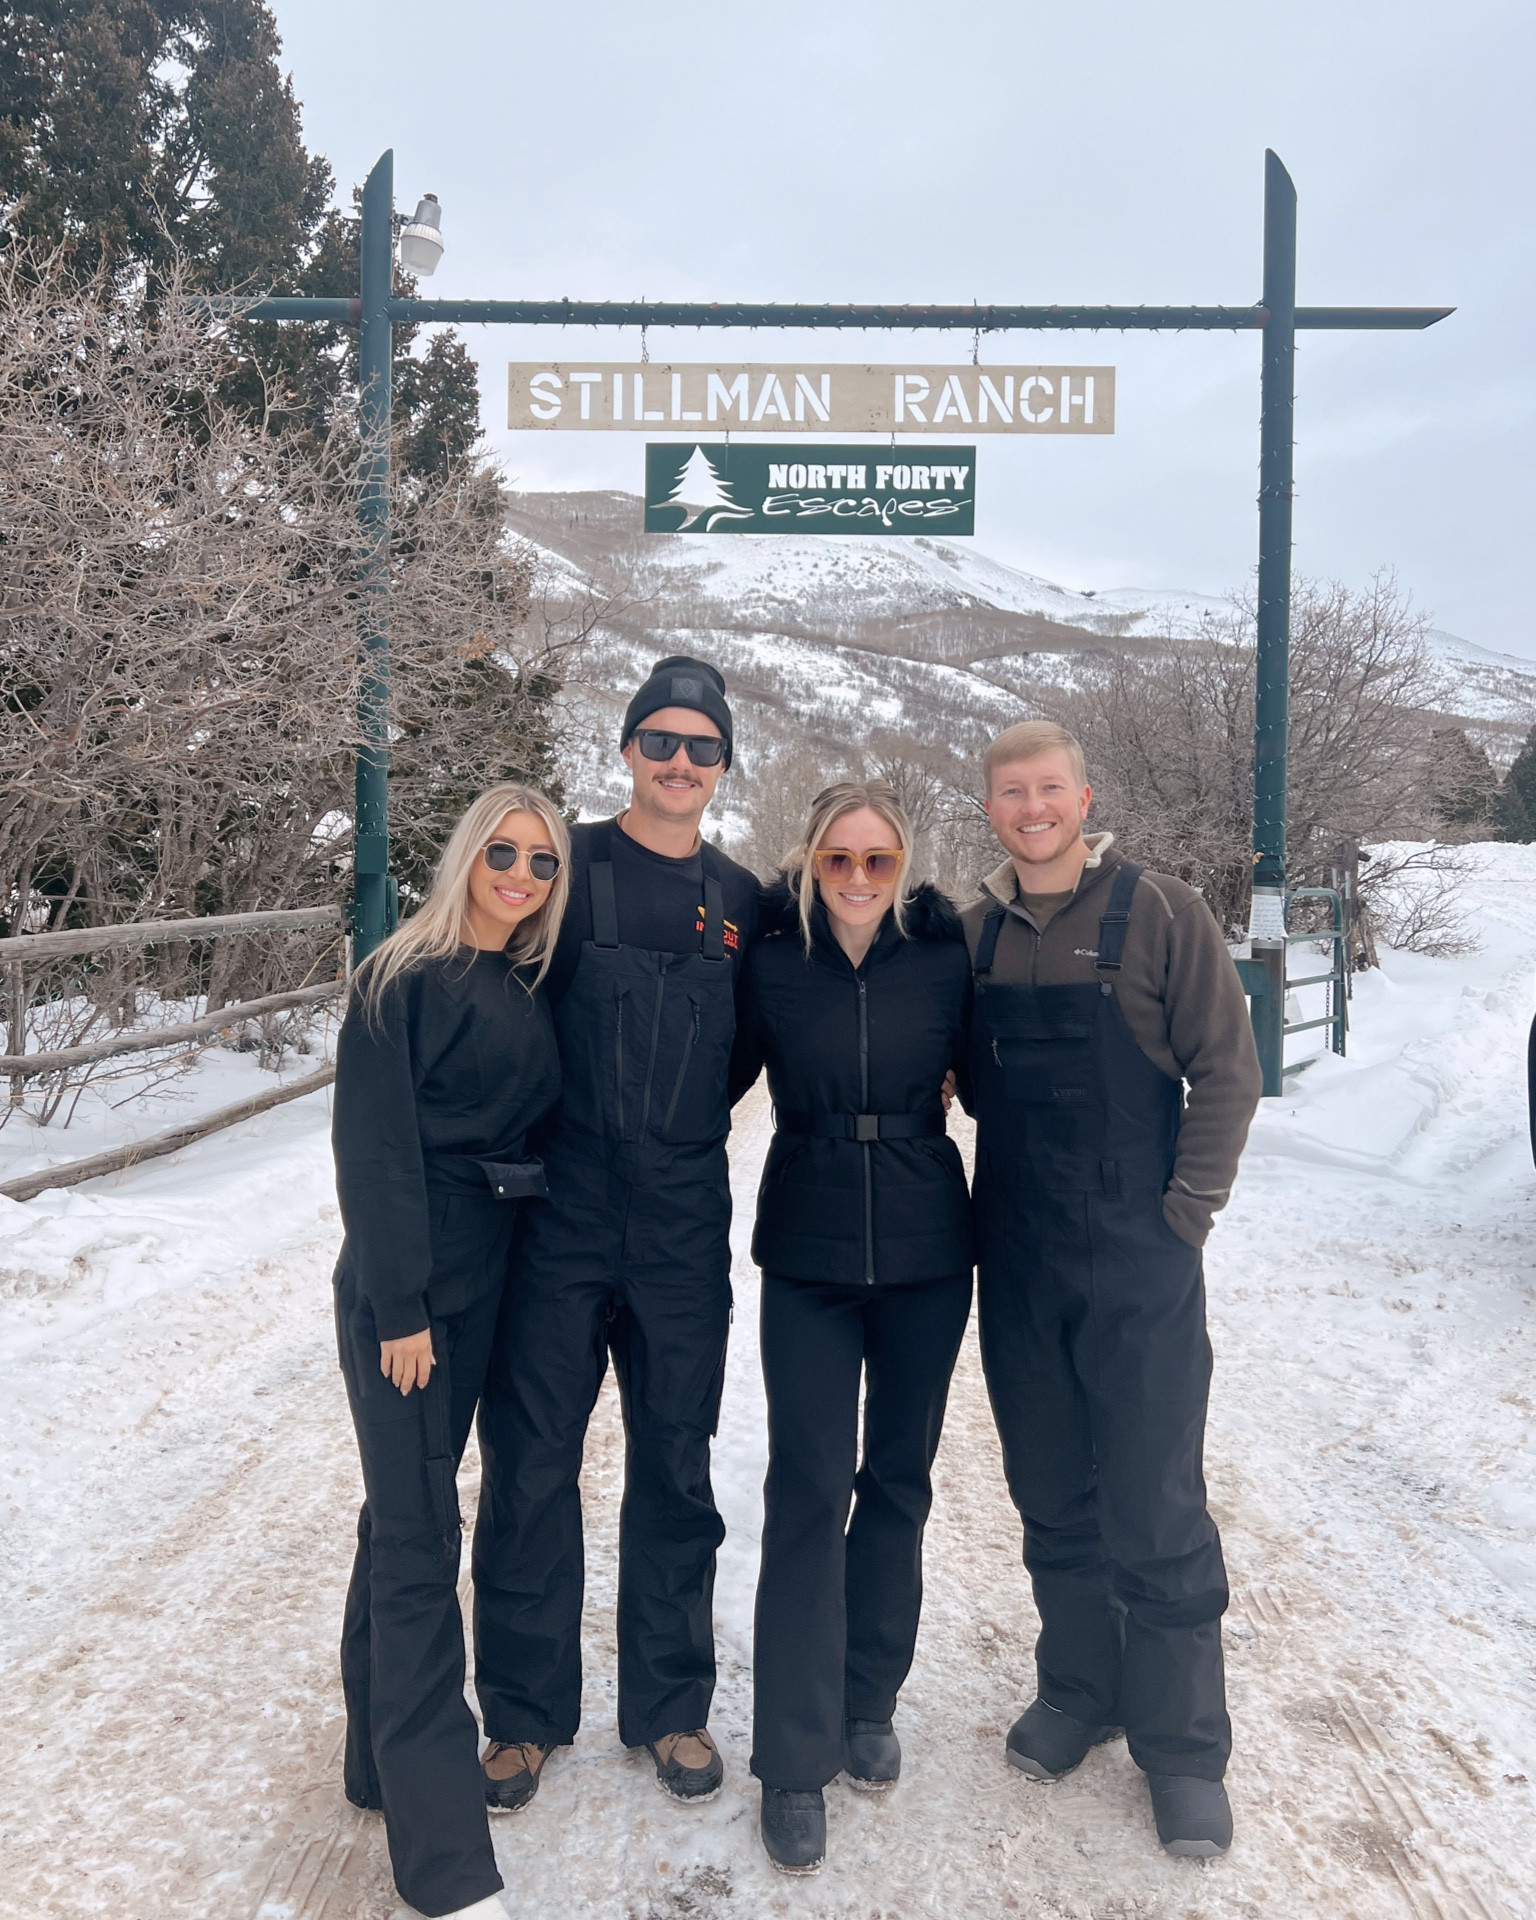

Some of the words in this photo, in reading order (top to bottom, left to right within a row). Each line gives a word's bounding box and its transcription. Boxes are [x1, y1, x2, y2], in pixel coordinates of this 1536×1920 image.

[529, 372, 831, 422] STILLMAN
[894, 374, 1095, 424] RANCH
[768, 463, 867, 490] NORTH
[875, 464, 970, 490] FORTY
[762, 493, 972, 526] Escapes
